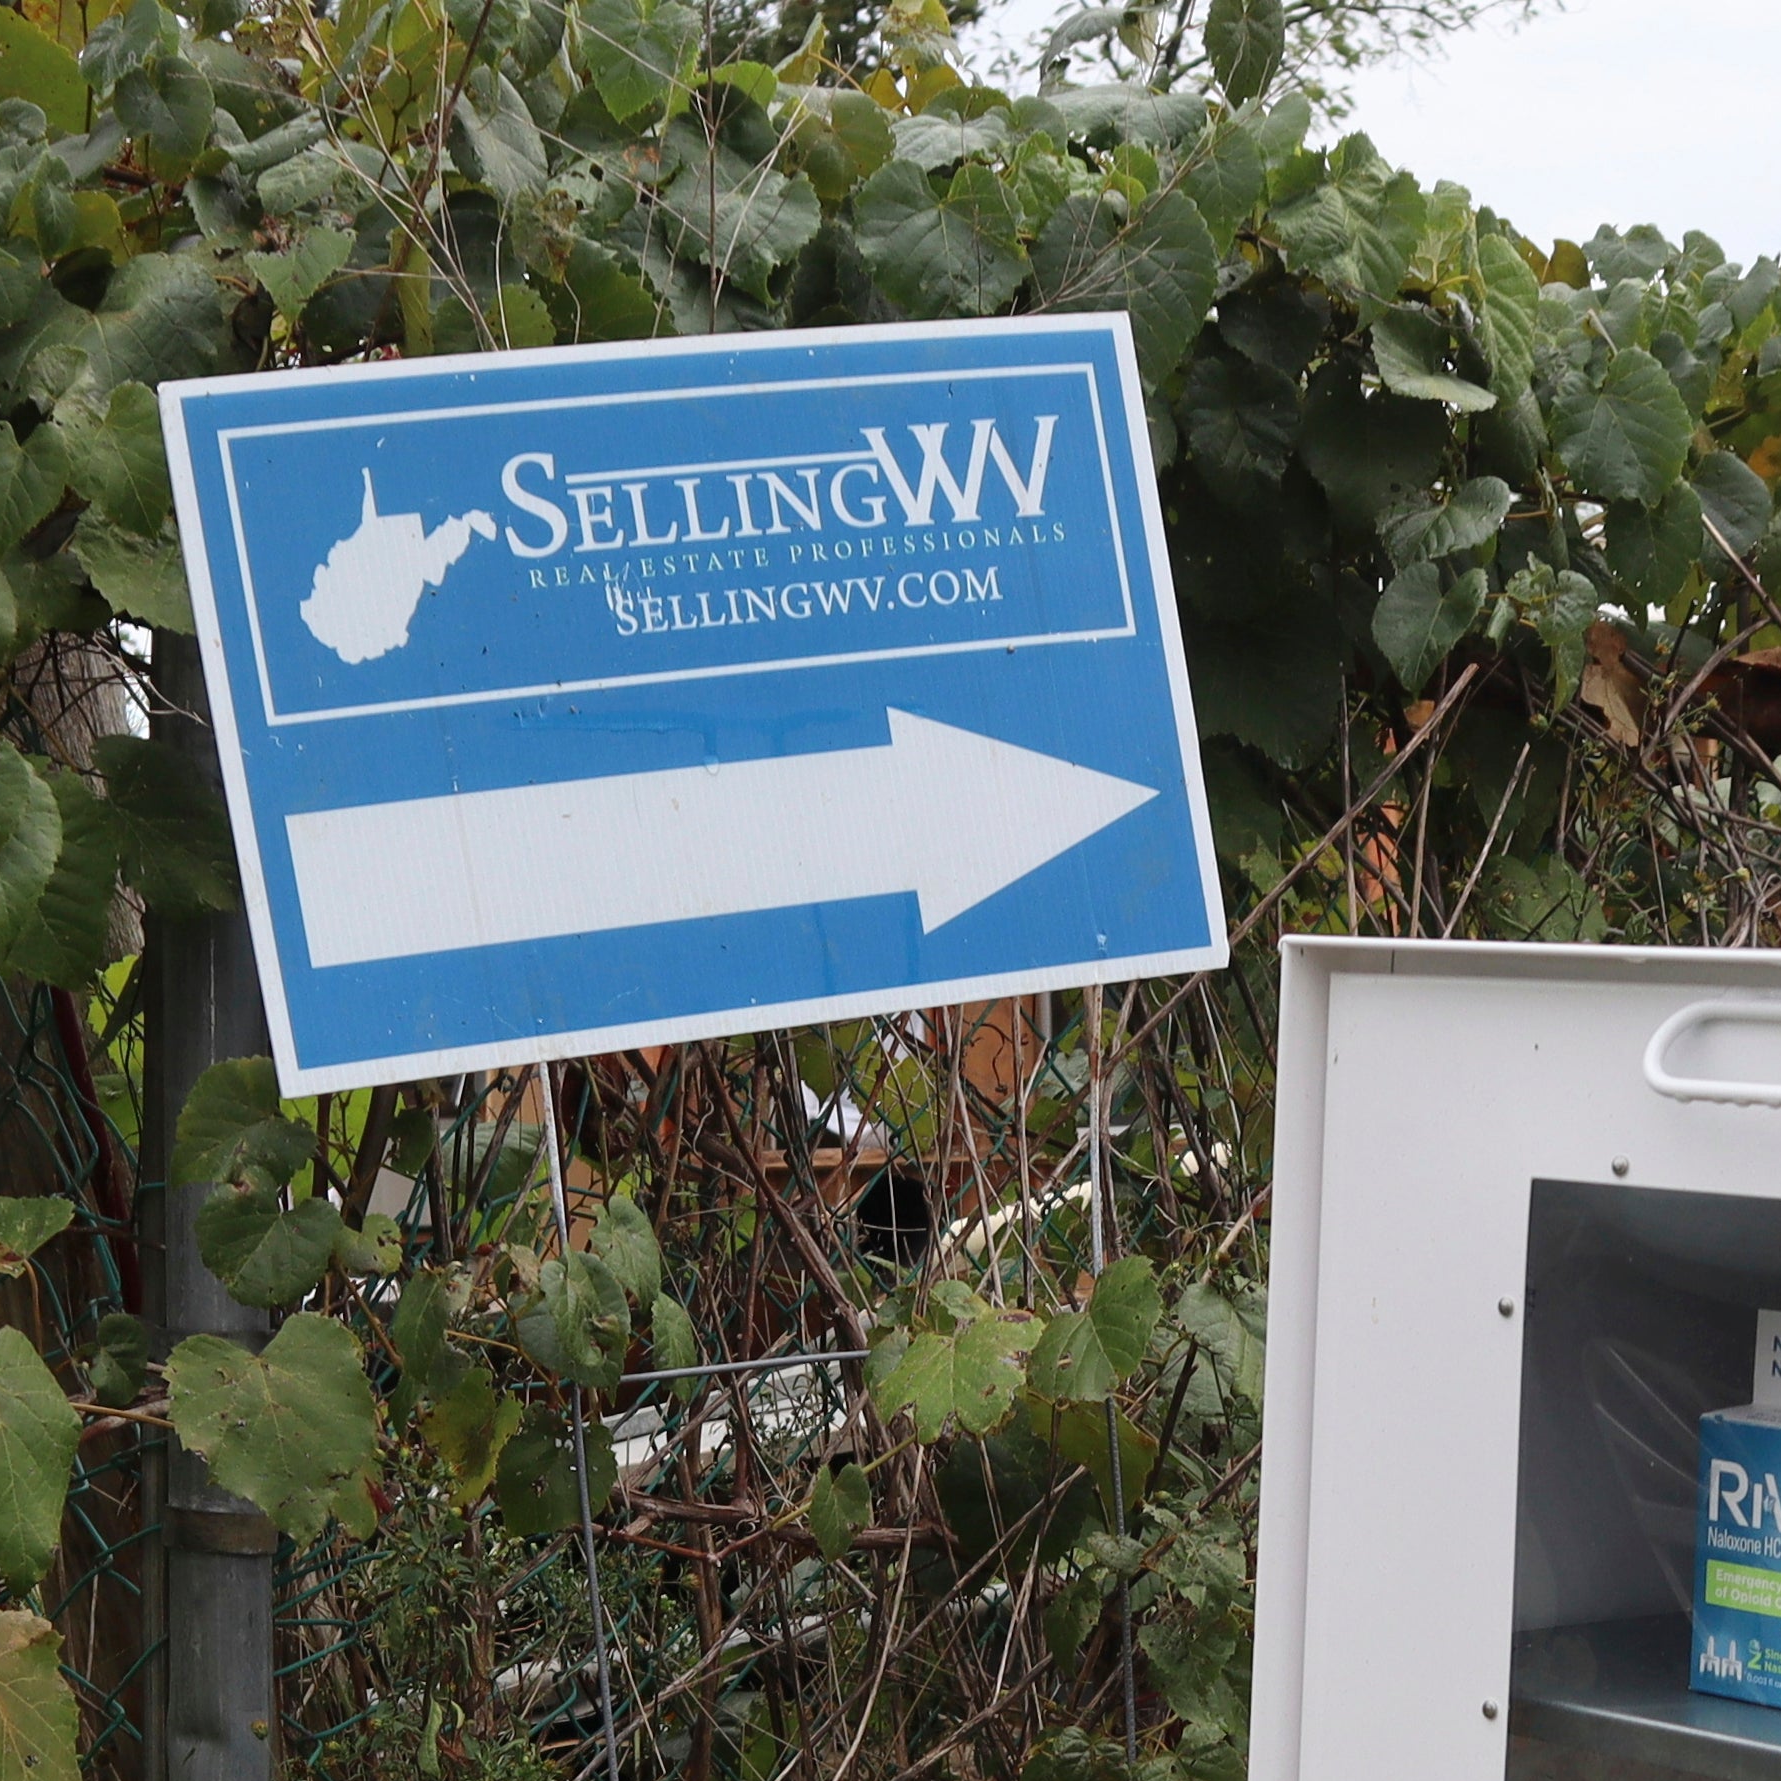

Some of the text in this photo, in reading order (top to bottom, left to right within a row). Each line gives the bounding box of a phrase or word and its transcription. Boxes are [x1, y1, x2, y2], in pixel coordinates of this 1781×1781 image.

[529, 521, 1066, 589] REAL ESTATE PROFESSIONALS
[615, 565, 1003, 636] SELLINGWV.COM
[1707, 1526, 1761, 1552] Naloxone
[1715, 1586, 1727, 1598] of
[1730, 1588, 1772, 1607] Opioid
